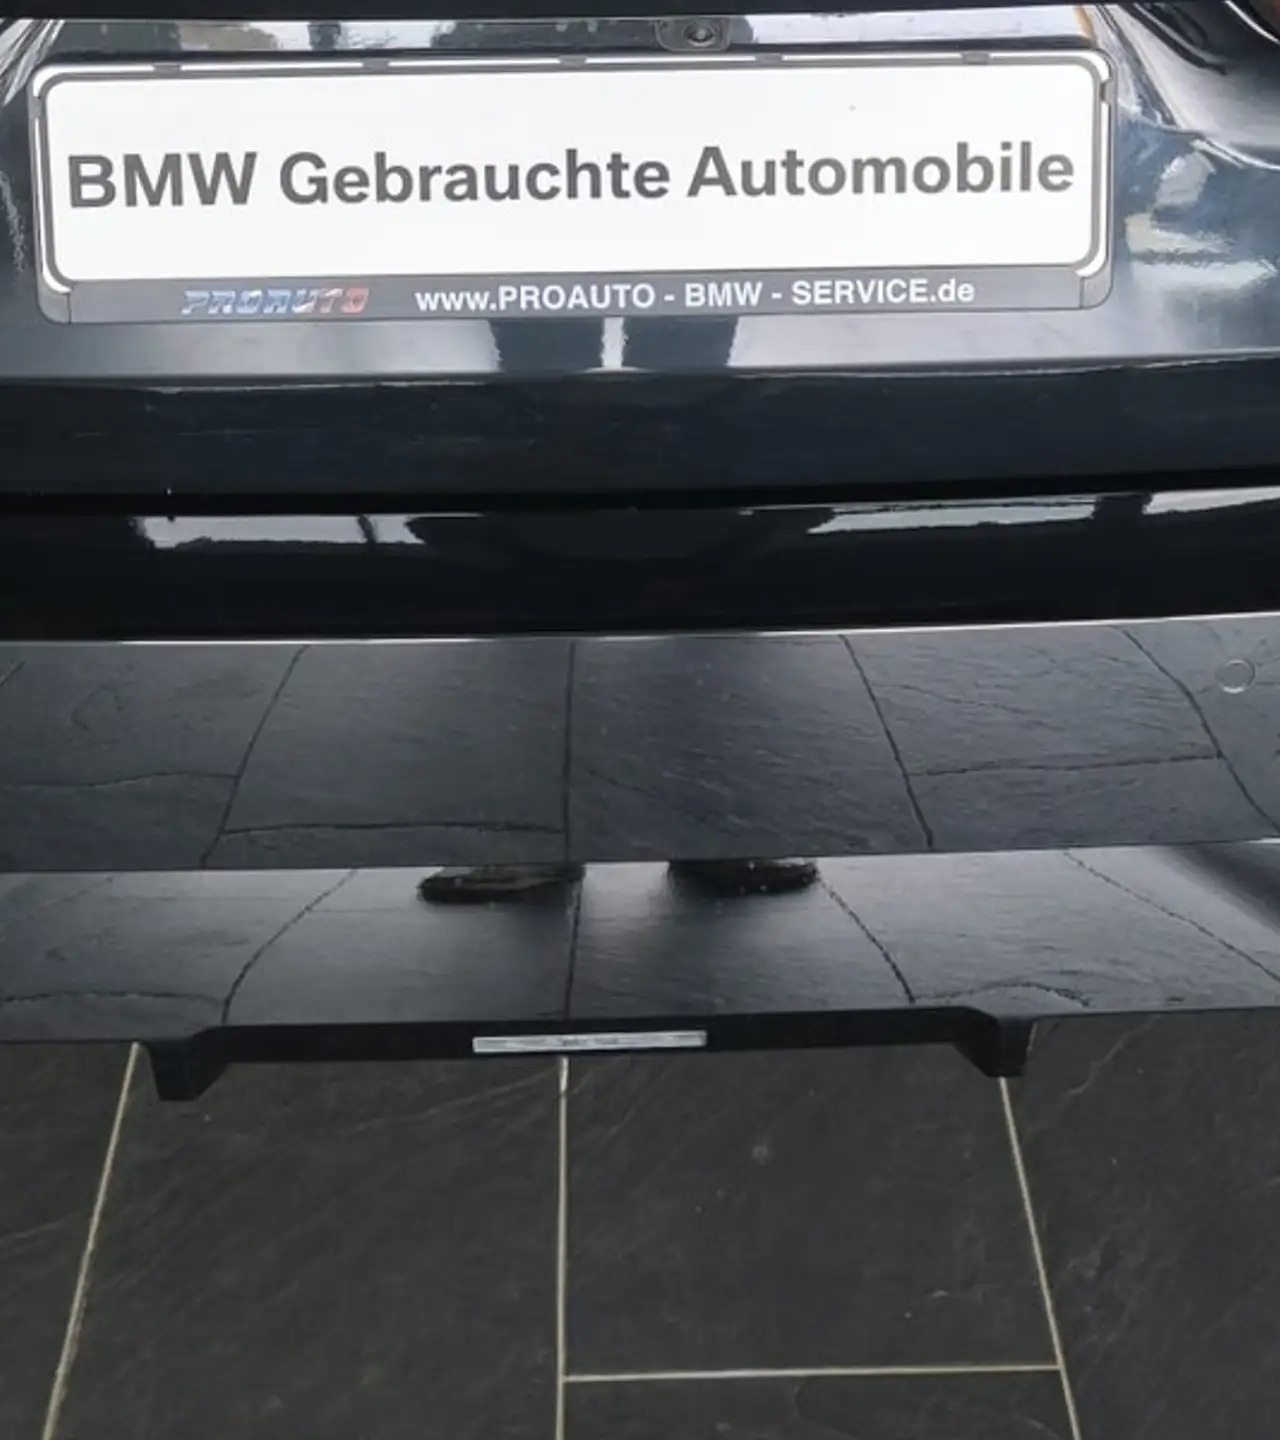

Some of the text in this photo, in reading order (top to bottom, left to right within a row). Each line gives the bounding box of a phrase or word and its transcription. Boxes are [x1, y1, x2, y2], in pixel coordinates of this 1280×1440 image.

[67, 140, 1075, 208] BMW Gebrauchte Automobile
[414, 282, 656, 311] www.PROAUTO
[684, 281, 763, 308] BMW
[791, 277, 976, 306] SERVICE.de
